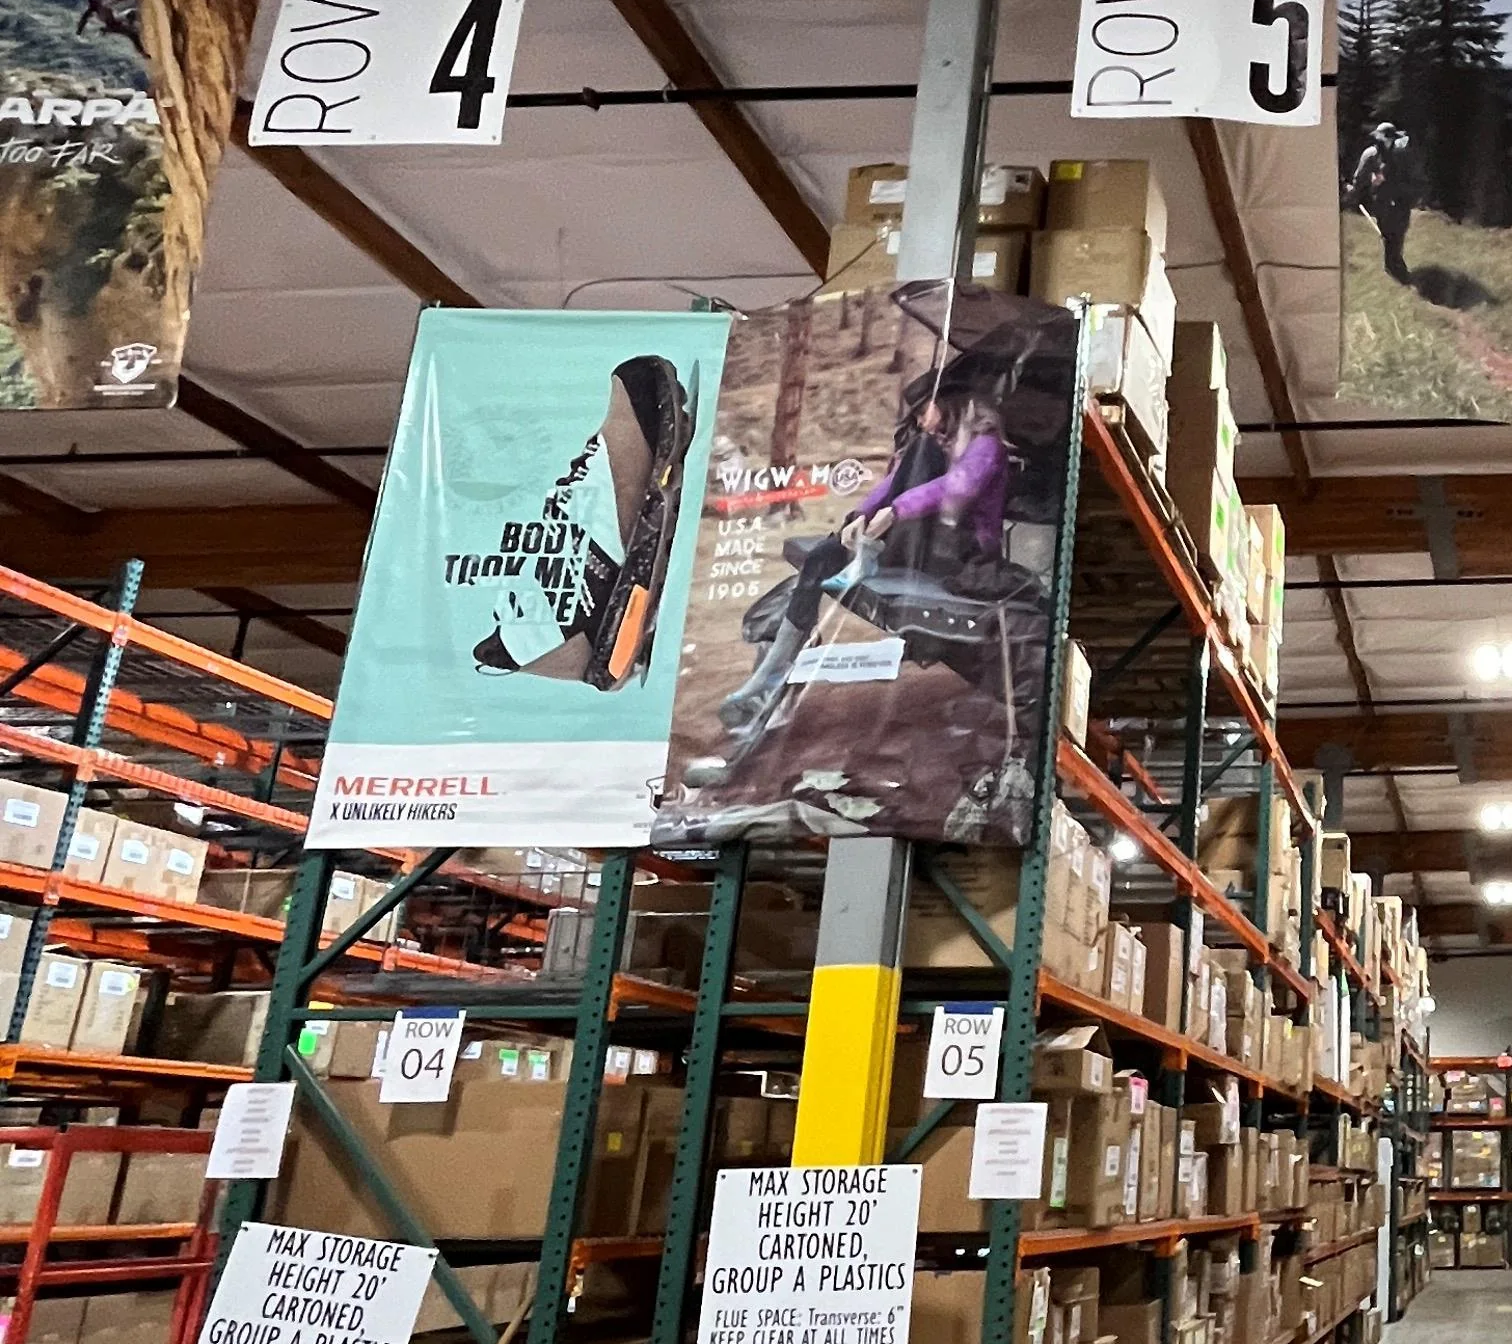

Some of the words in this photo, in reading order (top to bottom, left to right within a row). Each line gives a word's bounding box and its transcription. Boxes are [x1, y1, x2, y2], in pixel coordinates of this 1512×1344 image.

[500, 522, 586, 554] BODY
[714, 538, 765, 557] MADE
[710, 558, 764, 578] SINCE
[335, 776, 499, 796] MERRELL
[330, 802, 341, 821] X
[342, 802, 406, 821] UNLIKELY
[407, 802, 458, 821] HIKERS
[405, 1021, 454, 1038] ROW
[944, 1018, 992, 1035] ROW
[401, 1048, 445, 1080] 04
[941, 1045, 986, 1076] 05
[749, 1170, 788, 1196] MAX
[801, 1168, 888, 1195] STORAGE
[758, 1200, 834, 1228] HEIGHT
[266, 1229, 311, 1258] MAX
[317, 1236, 404, 1272] STORAGE
[758, 1232, 867, 1262] CARTONED,
[268, 1261, 346, 1295] HEIGHT
[712, 1266, 783, 1294] GROUP
[792, 1265, 805, 1292] A
[819, 1262, 906, 1291] PLASTICS
[262, 1293, 365, 1337] CARTONED,
[715, 1309, 748, 1328] FLUE
